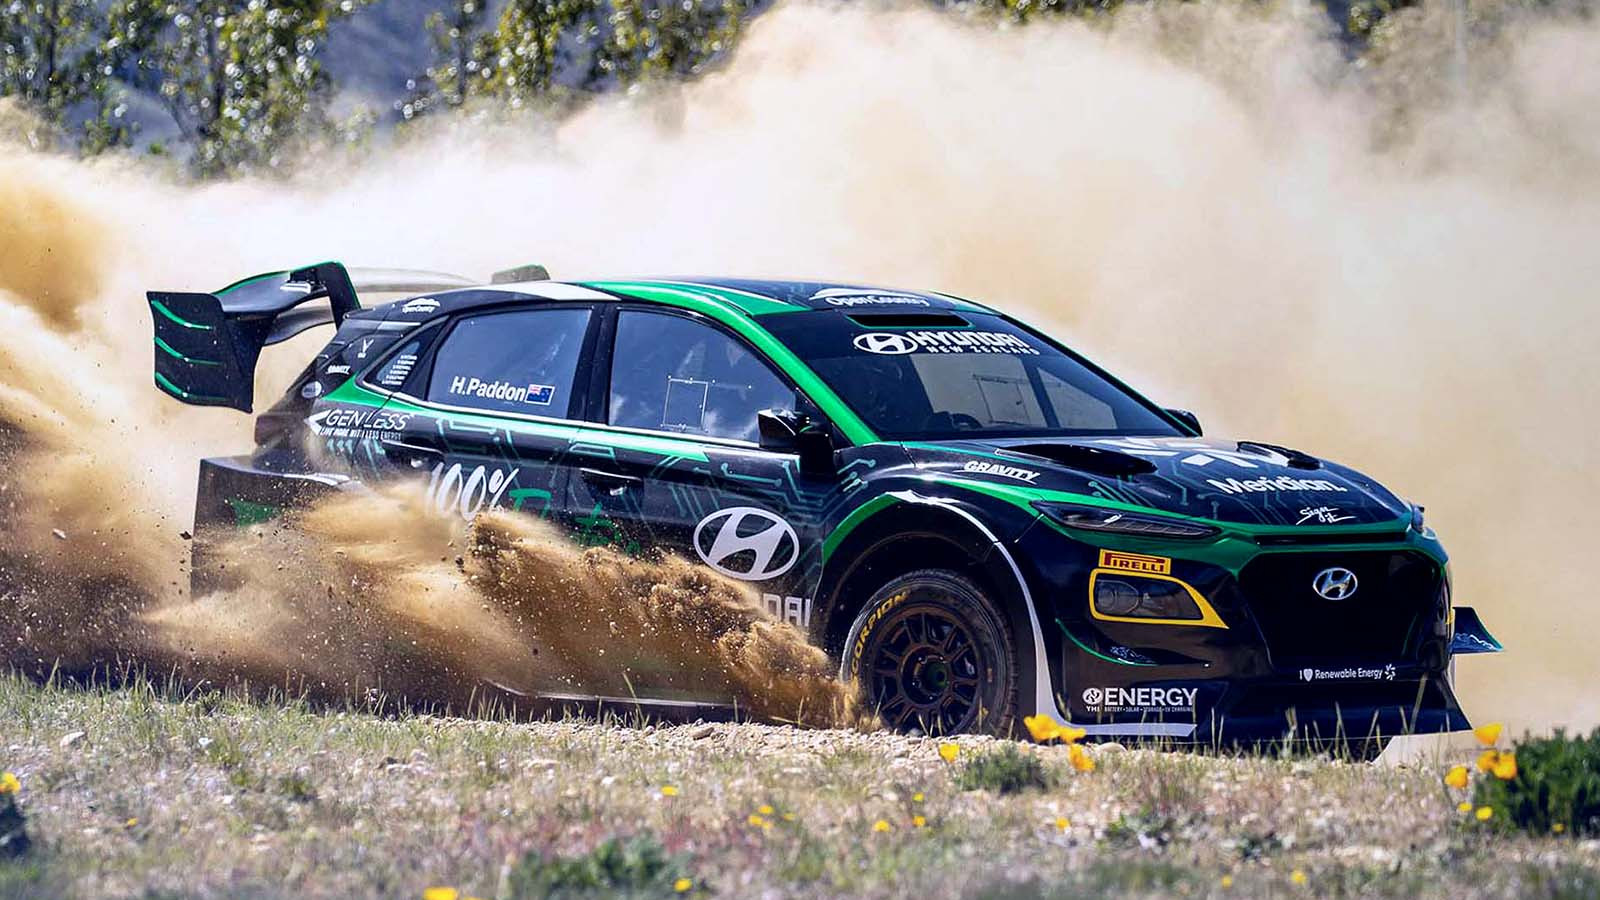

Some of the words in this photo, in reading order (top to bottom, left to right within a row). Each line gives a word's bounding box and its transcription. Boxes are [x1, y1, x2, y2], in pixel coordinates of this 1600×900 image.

[906, 331, 1030, 348] HYUNDAI
[926, 345, 963, 353] NEW
[450, 376, 526, 402] H.Paddon
[963, 461, 1041, 481] GRAVITY
[427, 462, 519, 521] 100%
[1104, 552, 1166, 573] PIRELLI
[1315, 668, 1357, 680] Renewable
[1357, 667, 1383, 680] Energy
[1104, 687, 1198, 706] ENERGY
